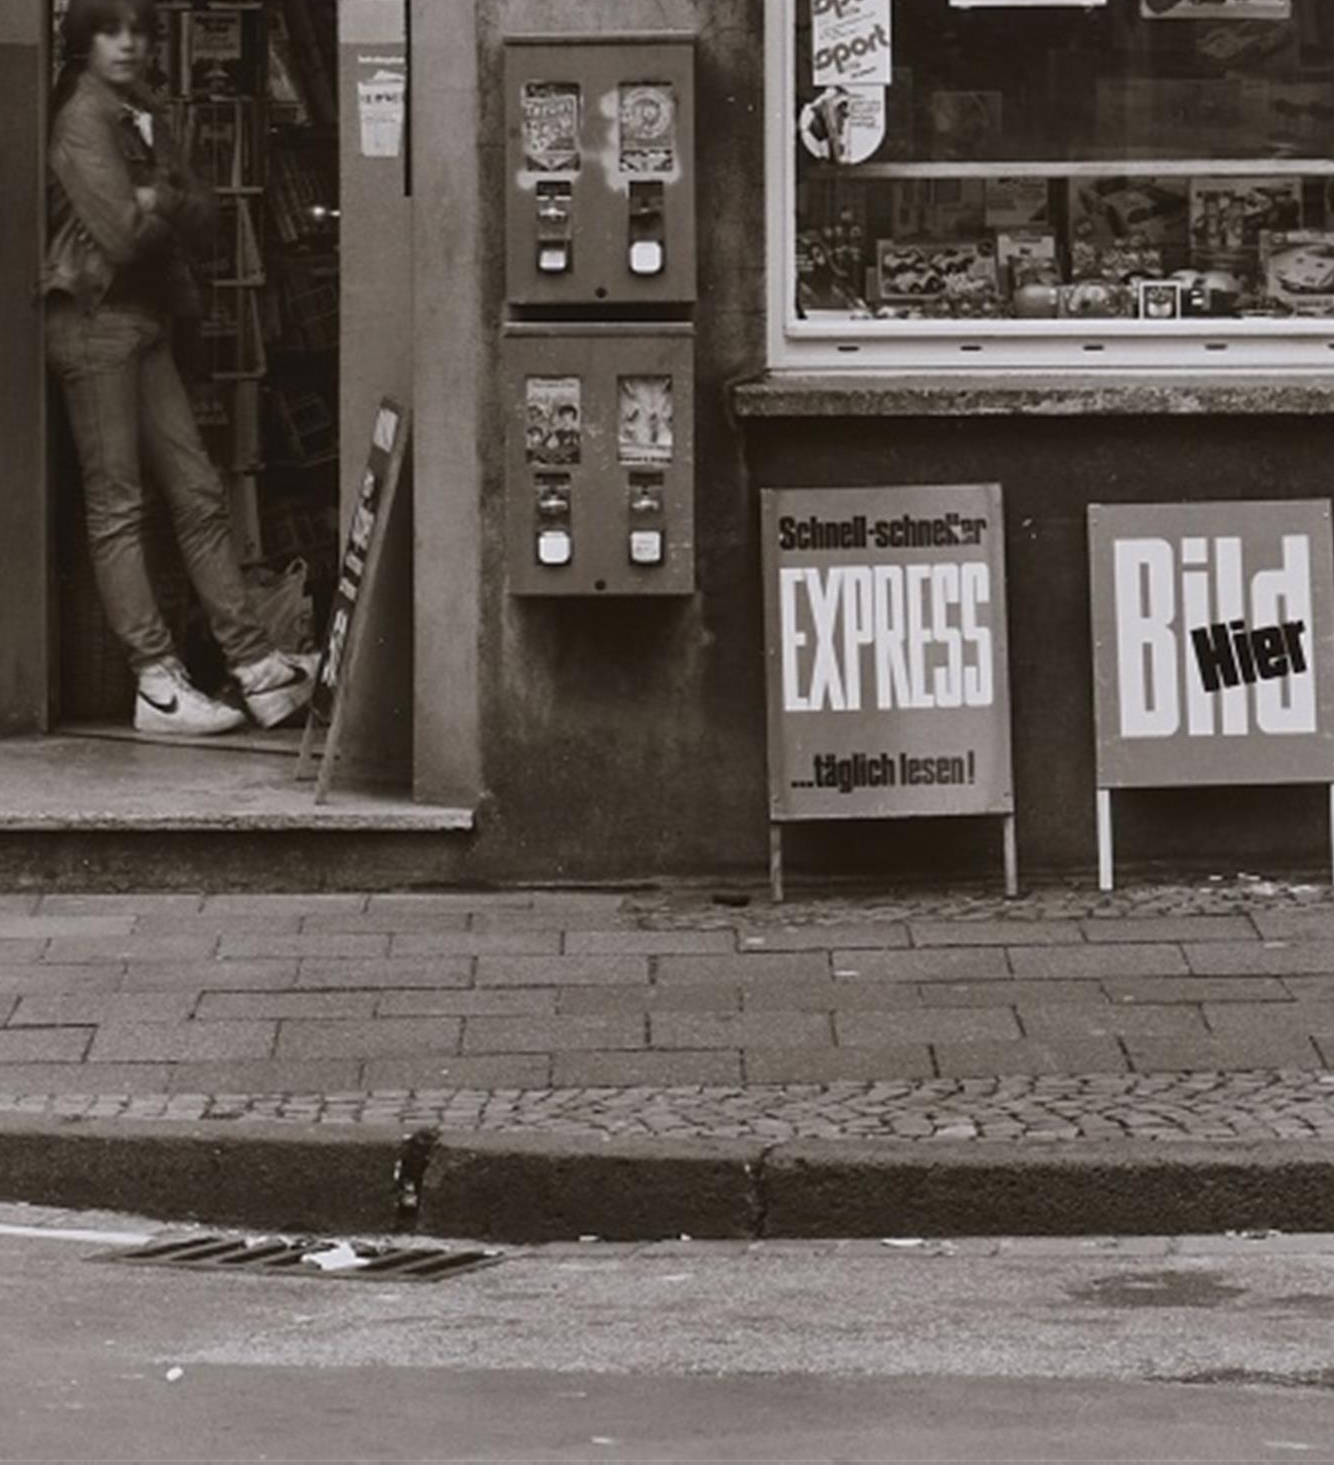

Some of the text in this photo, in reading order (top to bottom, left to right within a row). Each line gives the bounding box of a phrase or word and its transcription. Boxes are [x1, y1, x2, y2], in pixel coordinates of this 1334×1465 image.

[813, 23, 890, 74] sport
[778, 562, 994, 712] EXPRESS
[1113, 534, 1317, 738] Bild
[1190, 618, 1307, 694] Hier
